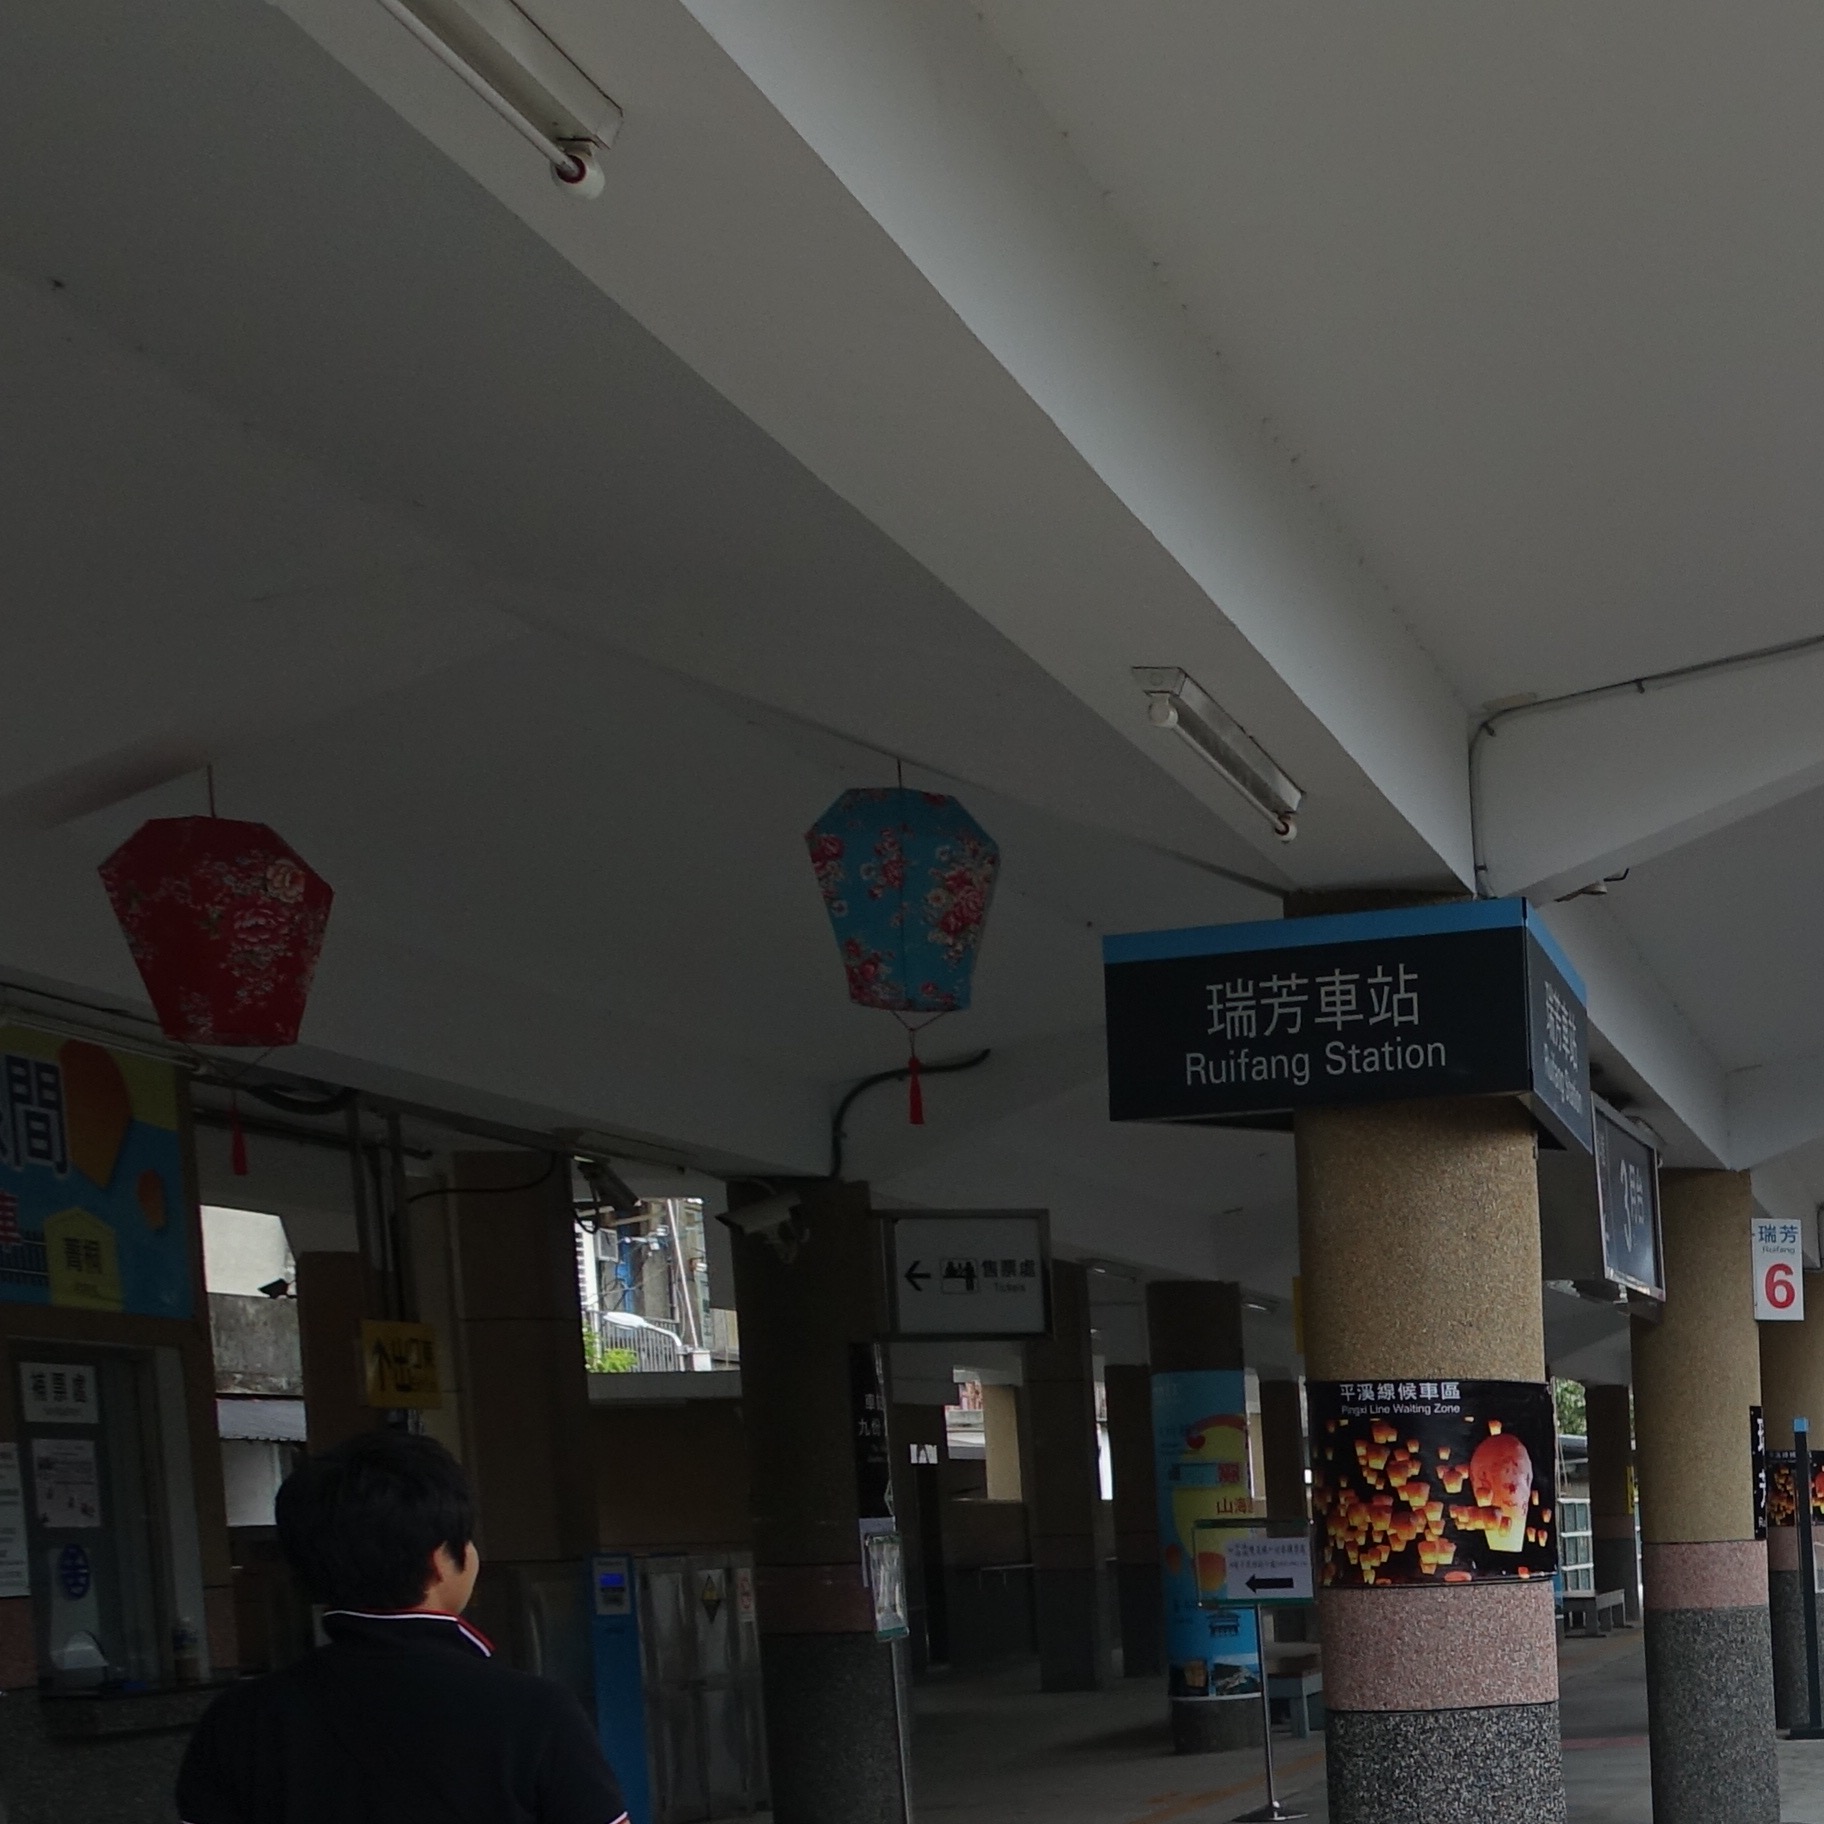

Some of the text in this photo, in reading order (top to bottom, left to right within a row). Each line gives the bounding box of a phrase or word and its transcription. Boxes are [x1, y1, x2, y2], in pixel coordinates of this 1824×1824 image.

[1206, 963, 1419, 1040] 瑞芳車站
[1186, 1036, 1446, 1086] Ruifang Station
[0, 1054, 68, 1174] 間
[1758, 1224, 1798, 1243] 瑞芳
[1764, 1262, 1796, 1310] 6
[1340, 1381, 1461, 1401] 平溪線候車區
[1341, 1403, 1461, 1417] Pingxi Line Waiting Zone
